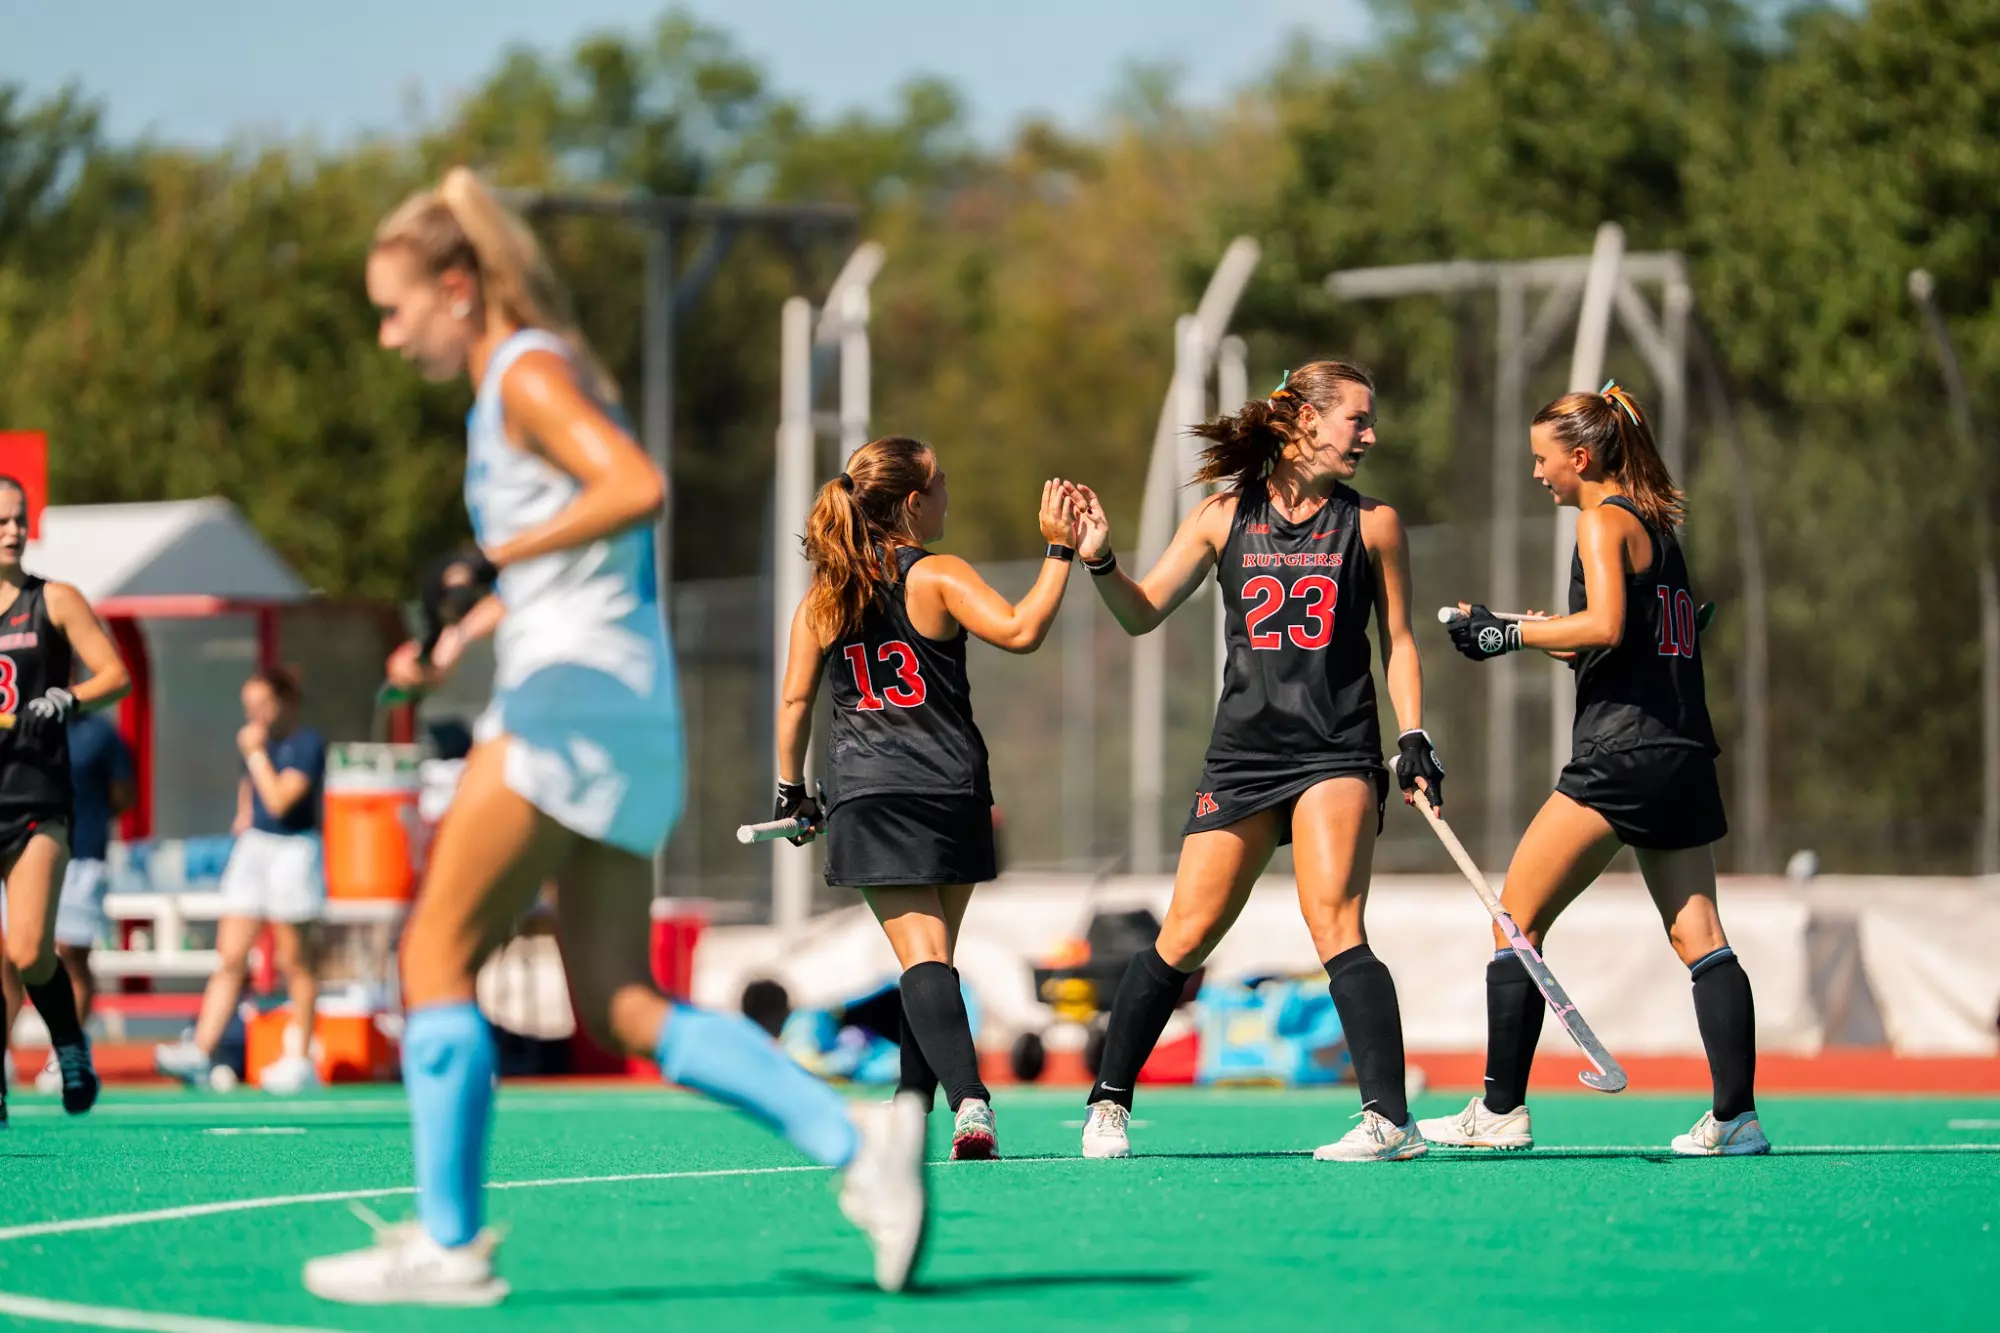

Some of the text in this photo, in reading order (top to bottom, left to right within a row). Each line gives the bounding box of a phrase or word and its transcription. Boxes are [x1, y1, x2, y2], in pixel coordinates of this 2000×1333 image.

[1242, 553, 1343, 568] RUTGERS
[1241, 575, 1338, 651] 23
[1657, 585, 1695, 658] 10
[844, 640, 927, 711] 13
